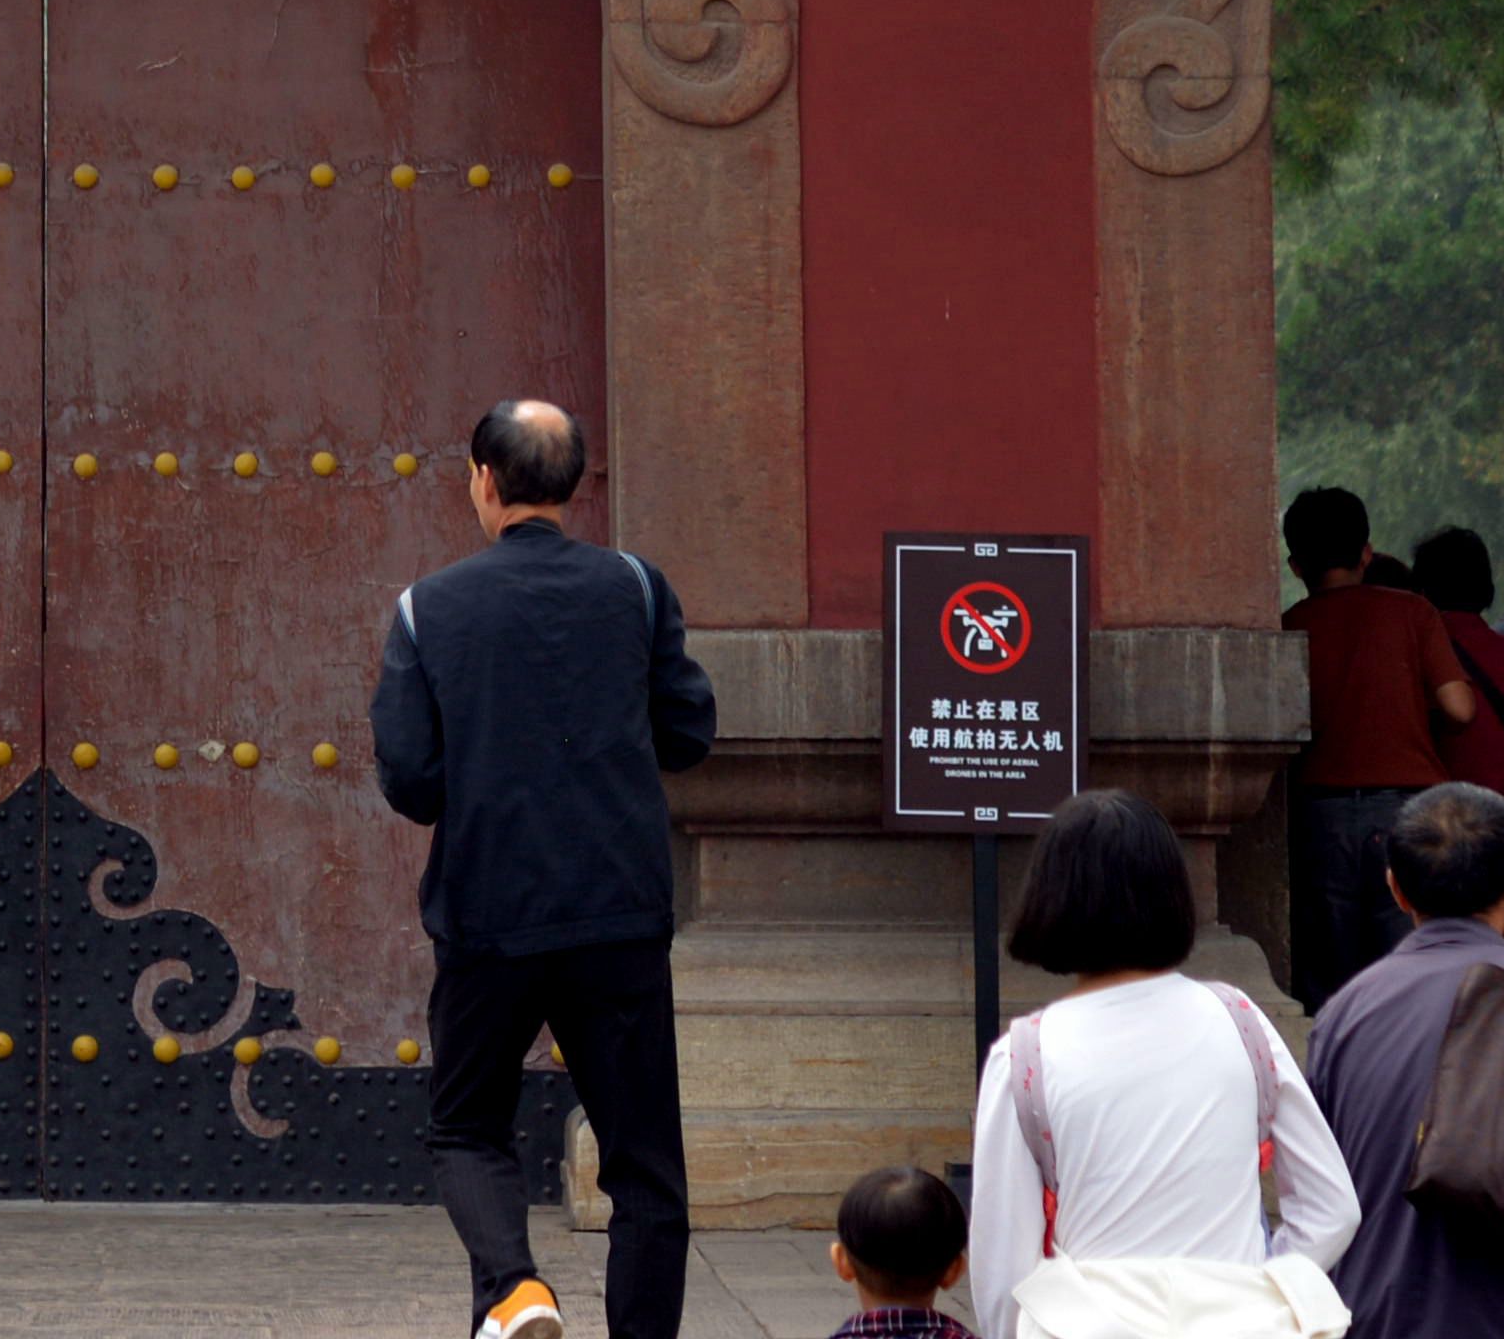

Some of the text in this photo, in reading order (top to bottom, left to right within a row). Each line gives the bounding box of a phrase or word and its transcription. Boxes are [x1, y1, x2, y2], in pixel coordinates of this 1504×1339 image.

[931, 697, 1040, 721] 禁止在景区
[908, 727, 1064, 751] 使用航拍无人机
[966, 757, 981, 765] THE
[982, 757, 998, 766] USE
[1000, 758, 1010, 766] OF
[1012, 758, 1040, 767] AERIAL
[944, 769, 1026, 779] DRONES IN THE AREA
